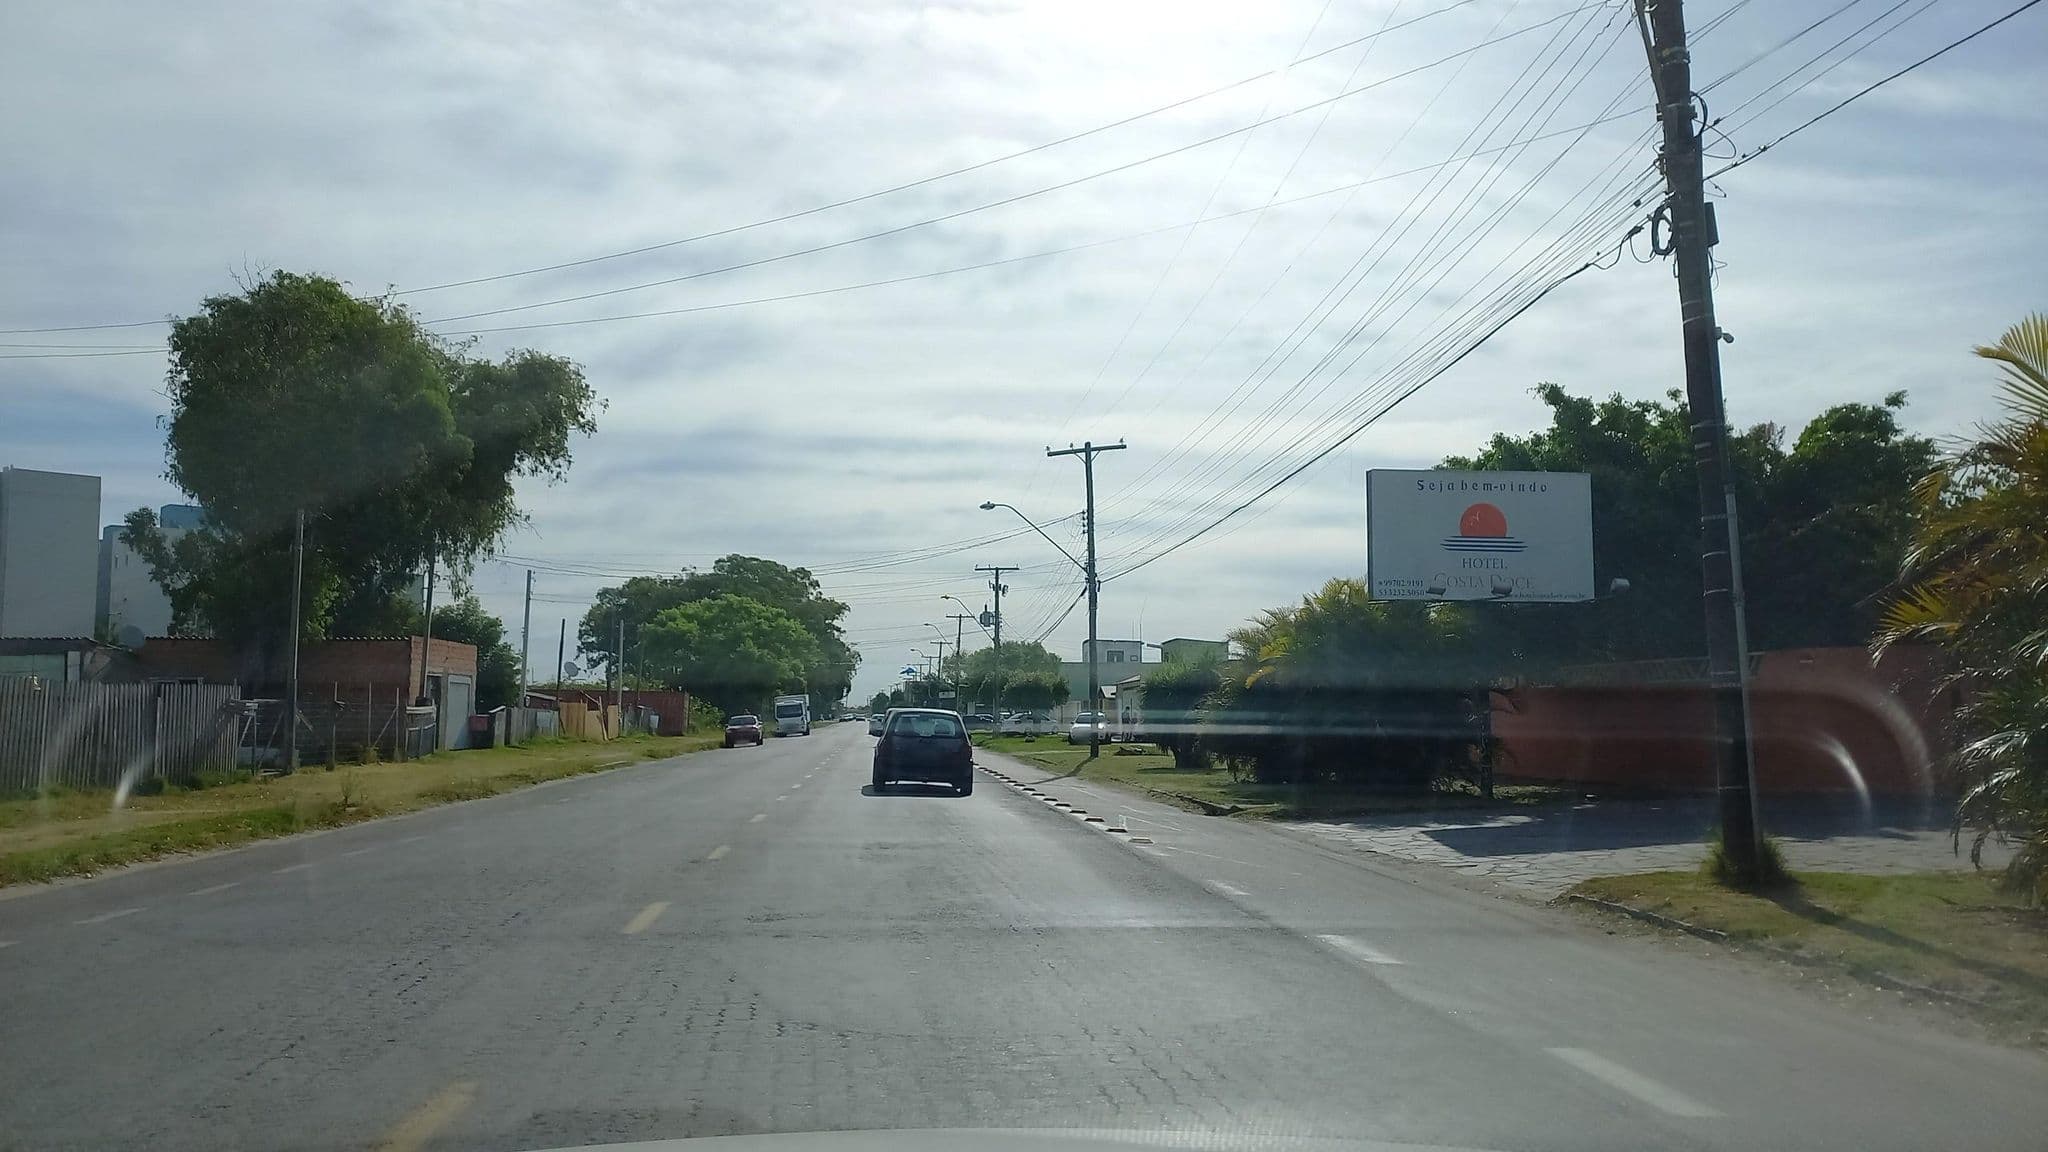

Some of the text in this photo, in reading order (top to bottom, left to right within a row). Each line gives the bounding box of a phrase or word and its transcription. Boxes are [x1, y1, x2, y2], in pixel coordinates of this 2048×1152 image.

[1417, 479, 1547, 493] Seja bem-vindo
[1462, 557, 1508, 569] HOTEL
